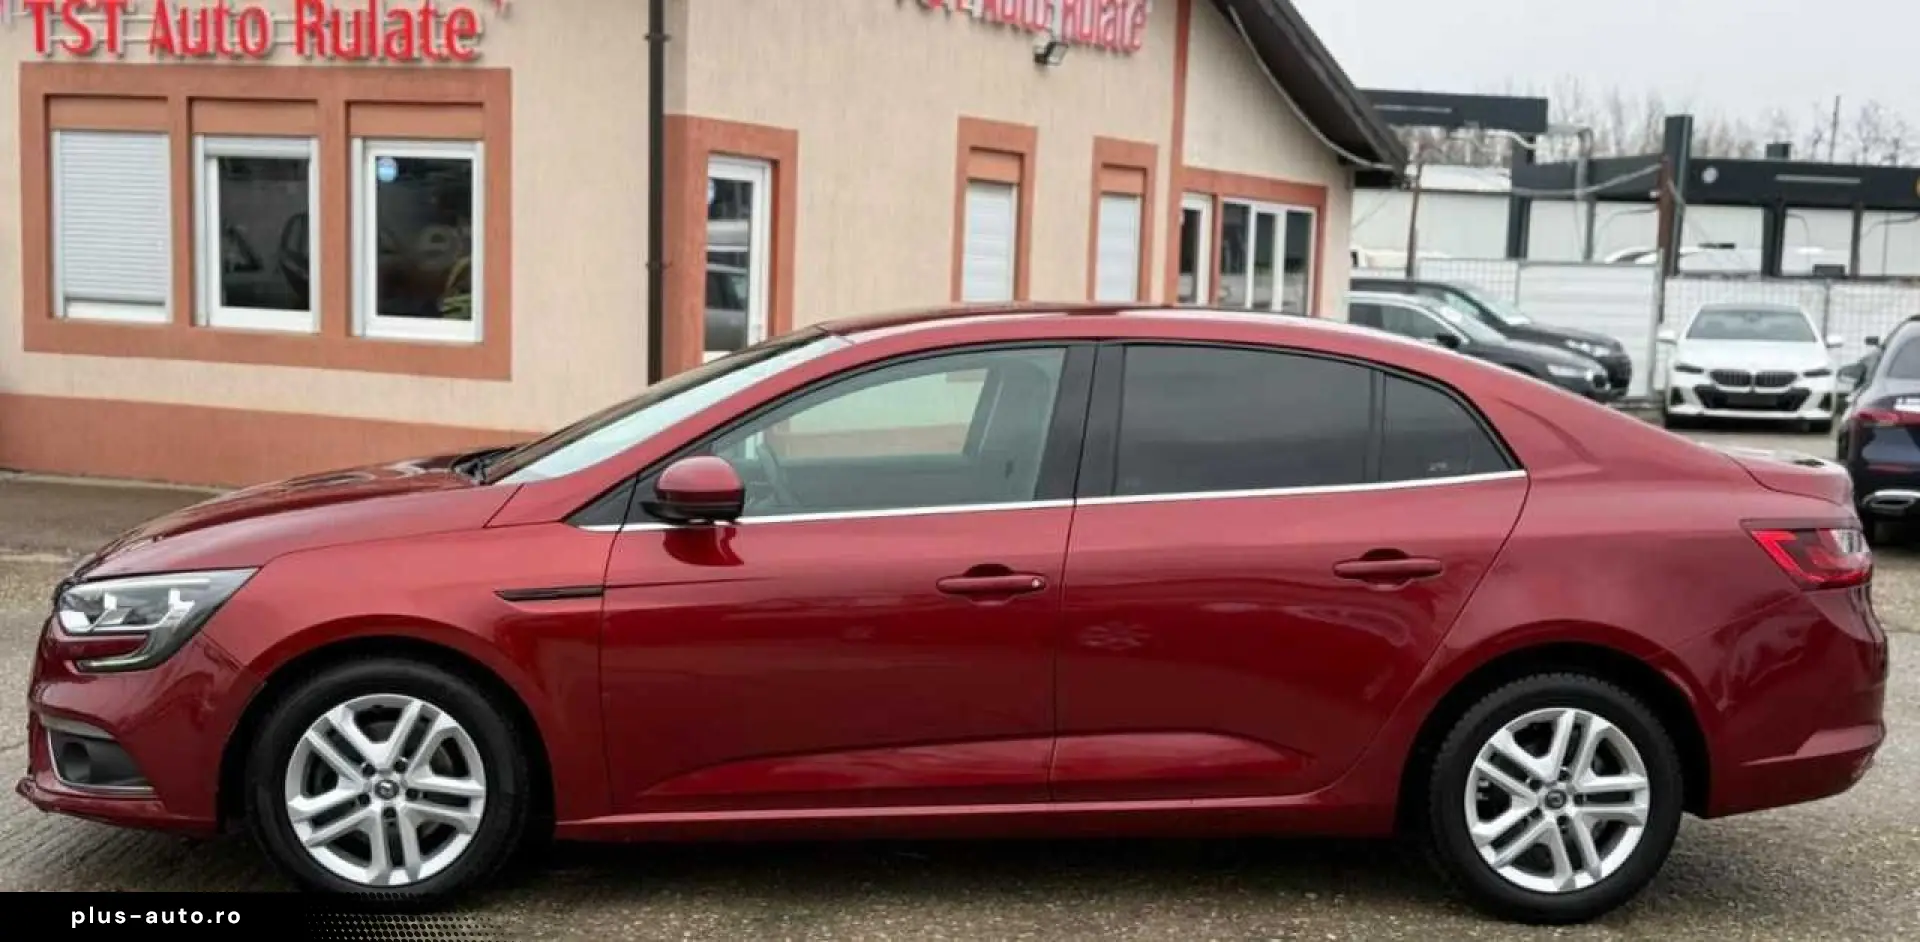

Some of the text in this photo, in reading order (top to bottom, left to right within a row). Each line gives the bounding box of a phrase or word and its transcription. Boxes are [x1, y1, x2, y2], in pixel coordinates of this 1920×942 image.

[24, 0, 479, 61] TST Auto Rulate
